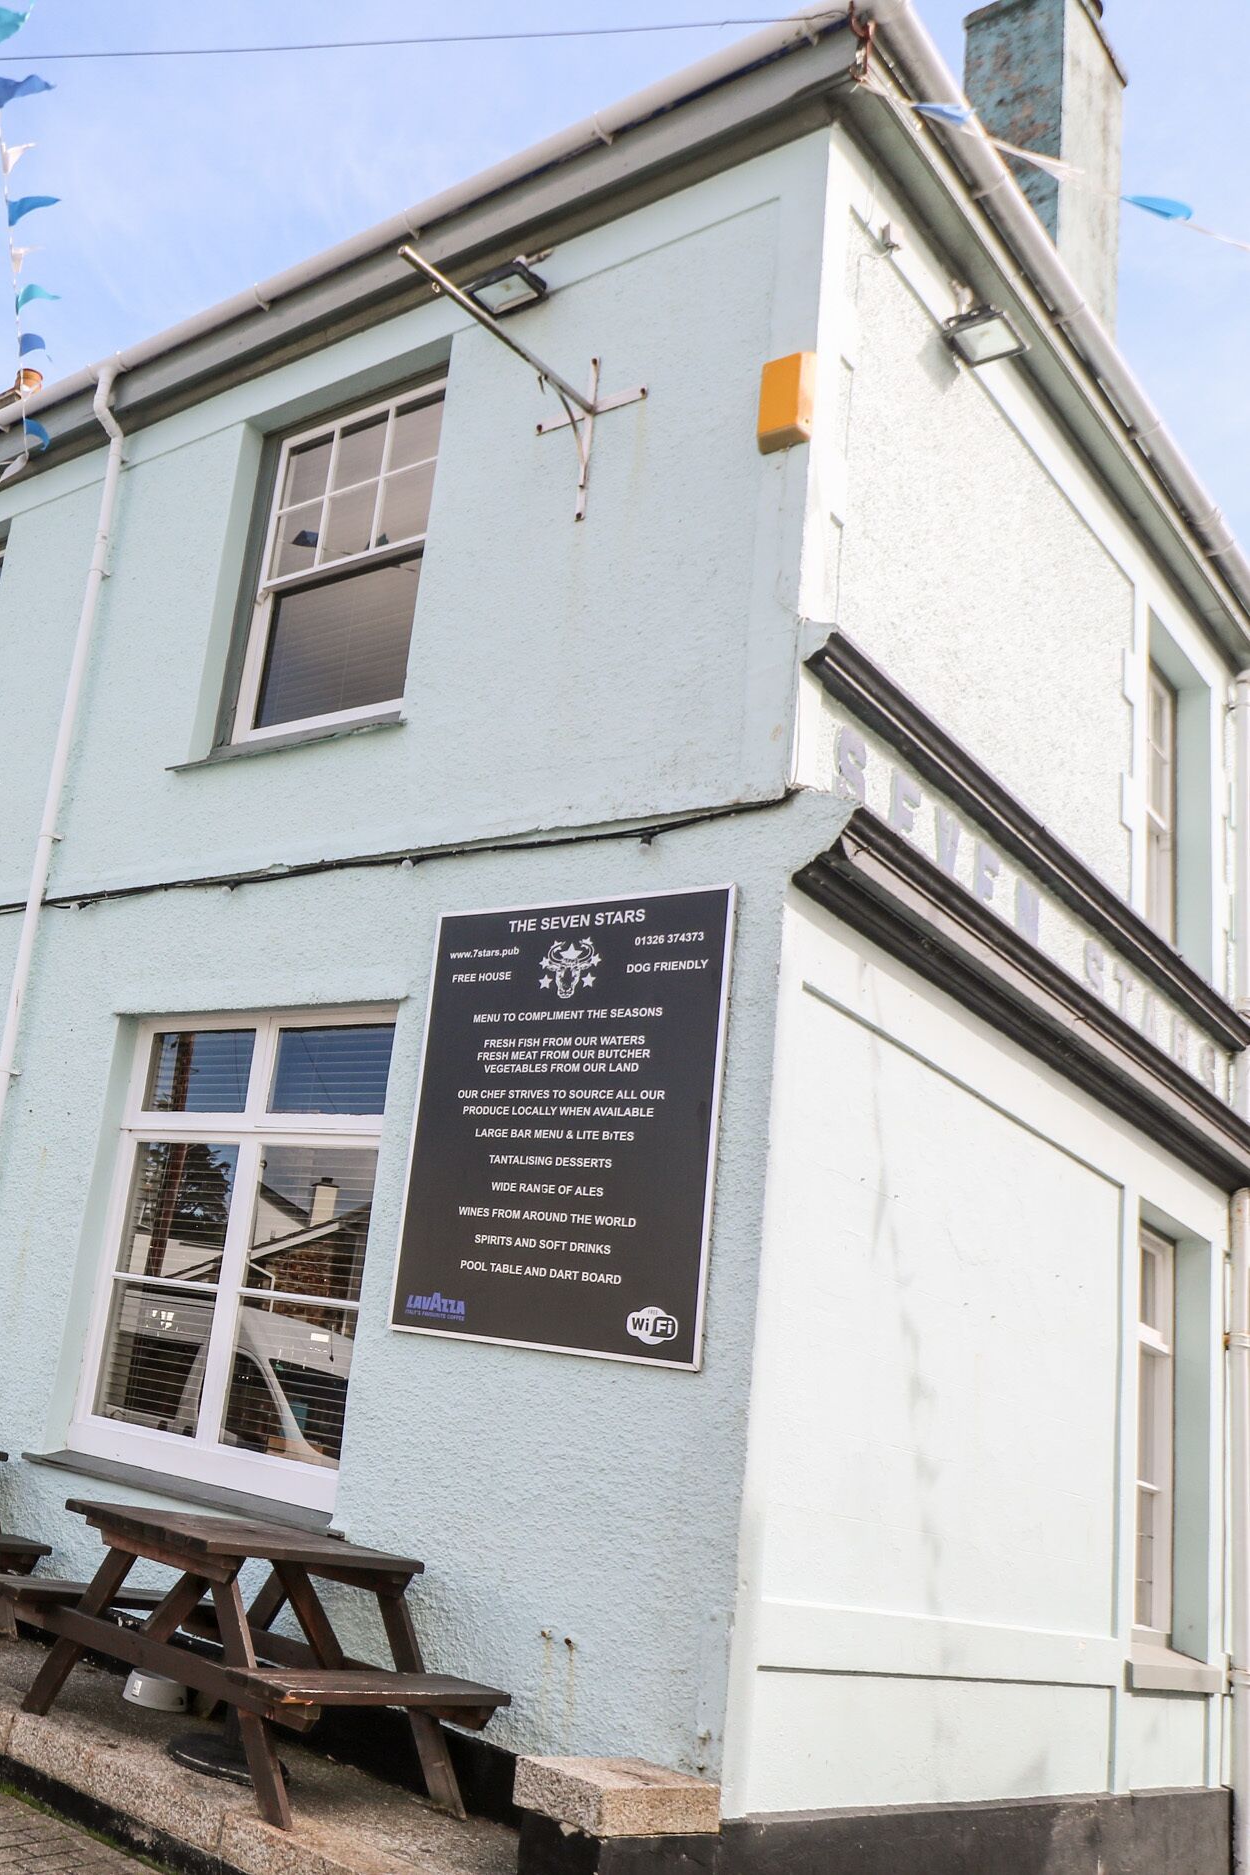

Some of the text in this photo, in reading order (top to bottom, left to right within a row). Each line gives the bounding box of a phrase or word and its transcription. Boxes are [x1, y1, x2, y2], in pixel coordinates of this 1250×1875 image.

[508, 908, 646, 933] THE SEVEN STARS
[634, 931, 705, 946] 01326 374373
[449, 945, 520, 959] www.7stars.pub
[626, 958, 709, 973] DOG FRIENDLY
[451, 970, 512, 983] FREE HOUSE
[472, 1006, 663, 1023] MENU TO COMPLIMENT THE SEASONS
[483, 1034, 646, 1048] FRESH FISH FROM OUR WATERS
[476, 1048, 651, 1061] FRESH MEAT FROM OUR BUTCHER
[483, 1062, 639, 1073] VEGETABLES FROM OUR LAND
[457, 1089, 666, 1100] OUR CHEF STRIVES TO SOURCE ALL OUR
[462, 1105, 654, 1117] PRODUCE LOCALLY WHEN AVAILABLE
[474, 1128, 509, 1138] LARGE
[510, 1128, 532, 1138] BAR
[533, 1129, 564, 1139] MENU
[565, 1129, 574, 1140] &
[576, 1129, 600, 1140] LITE
[488, 1154, 612, 1169] TANTALISING DESSERTS
[491, 1181, 604, 1197] WIDE RANGE OF ALES
[458, 1205, 637, 1228] WINES FROM AROUND THE WORLD
[474, 1233, 611, 1255] SPIRITS AND SOFT DRINKS
[459, 1259, 622, 1285] POOL TABLE AND DART BOARD
[406, 1292, 466, 1315] LAVAZZA
